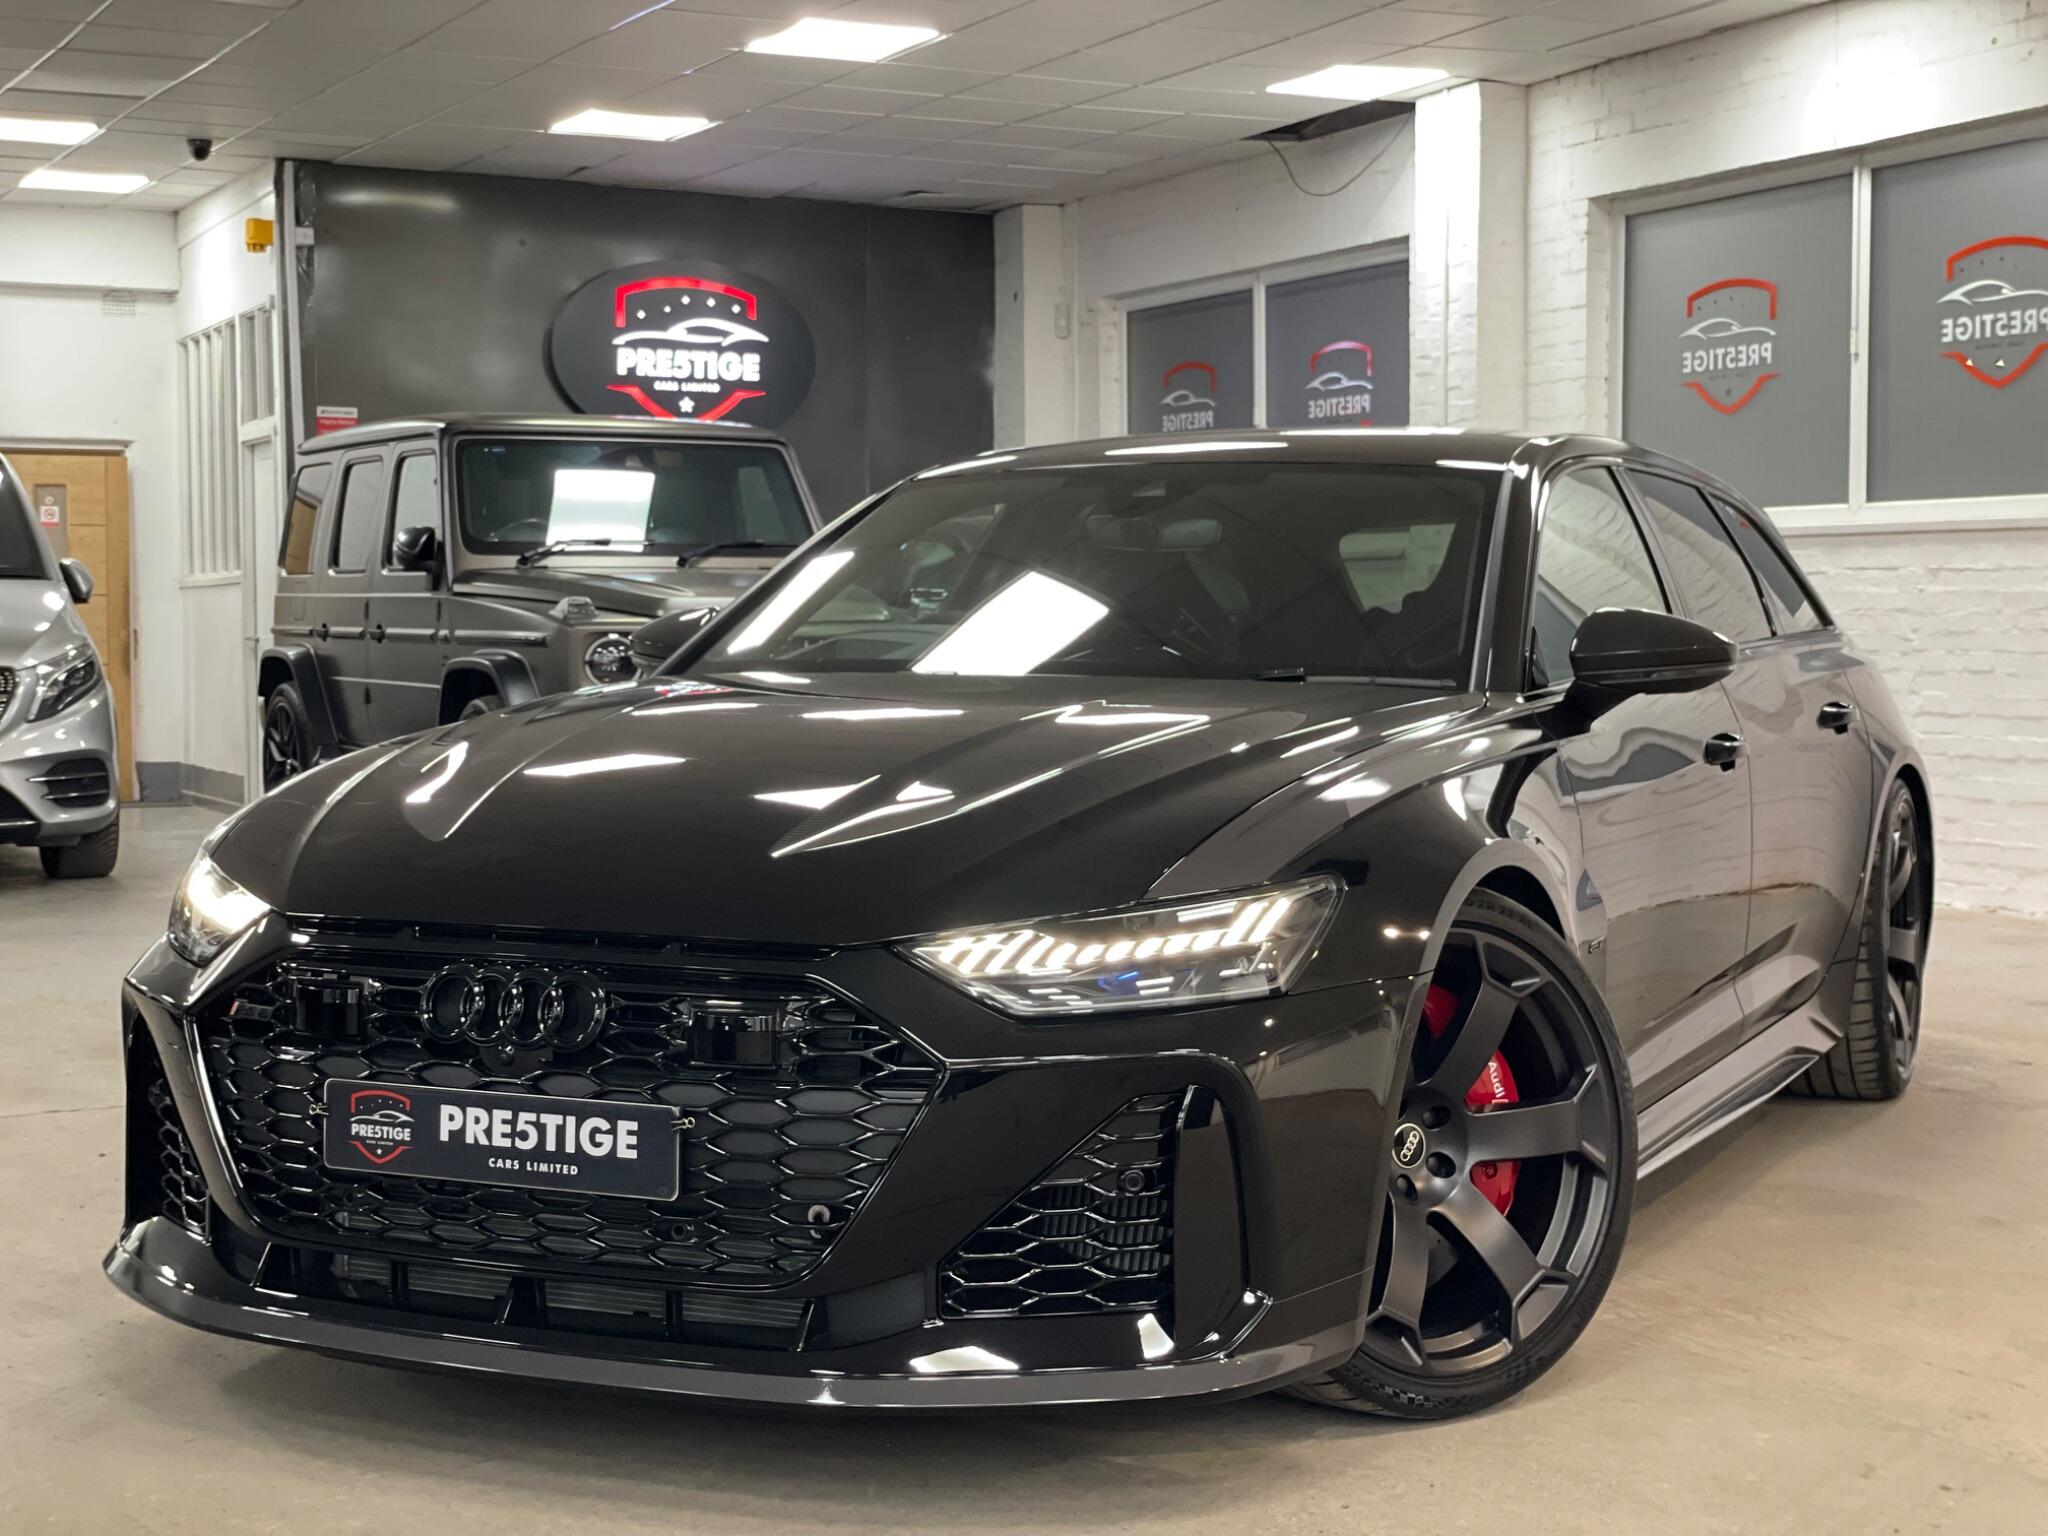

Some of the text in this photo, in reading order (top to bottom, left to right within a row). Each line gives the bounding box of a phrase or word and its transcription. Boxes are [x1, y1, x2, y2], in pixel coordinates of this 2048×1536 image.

[1487, 1062, 1506, 1099] Audi
[488, 1157, 578, 1175] CARS LIMITED
